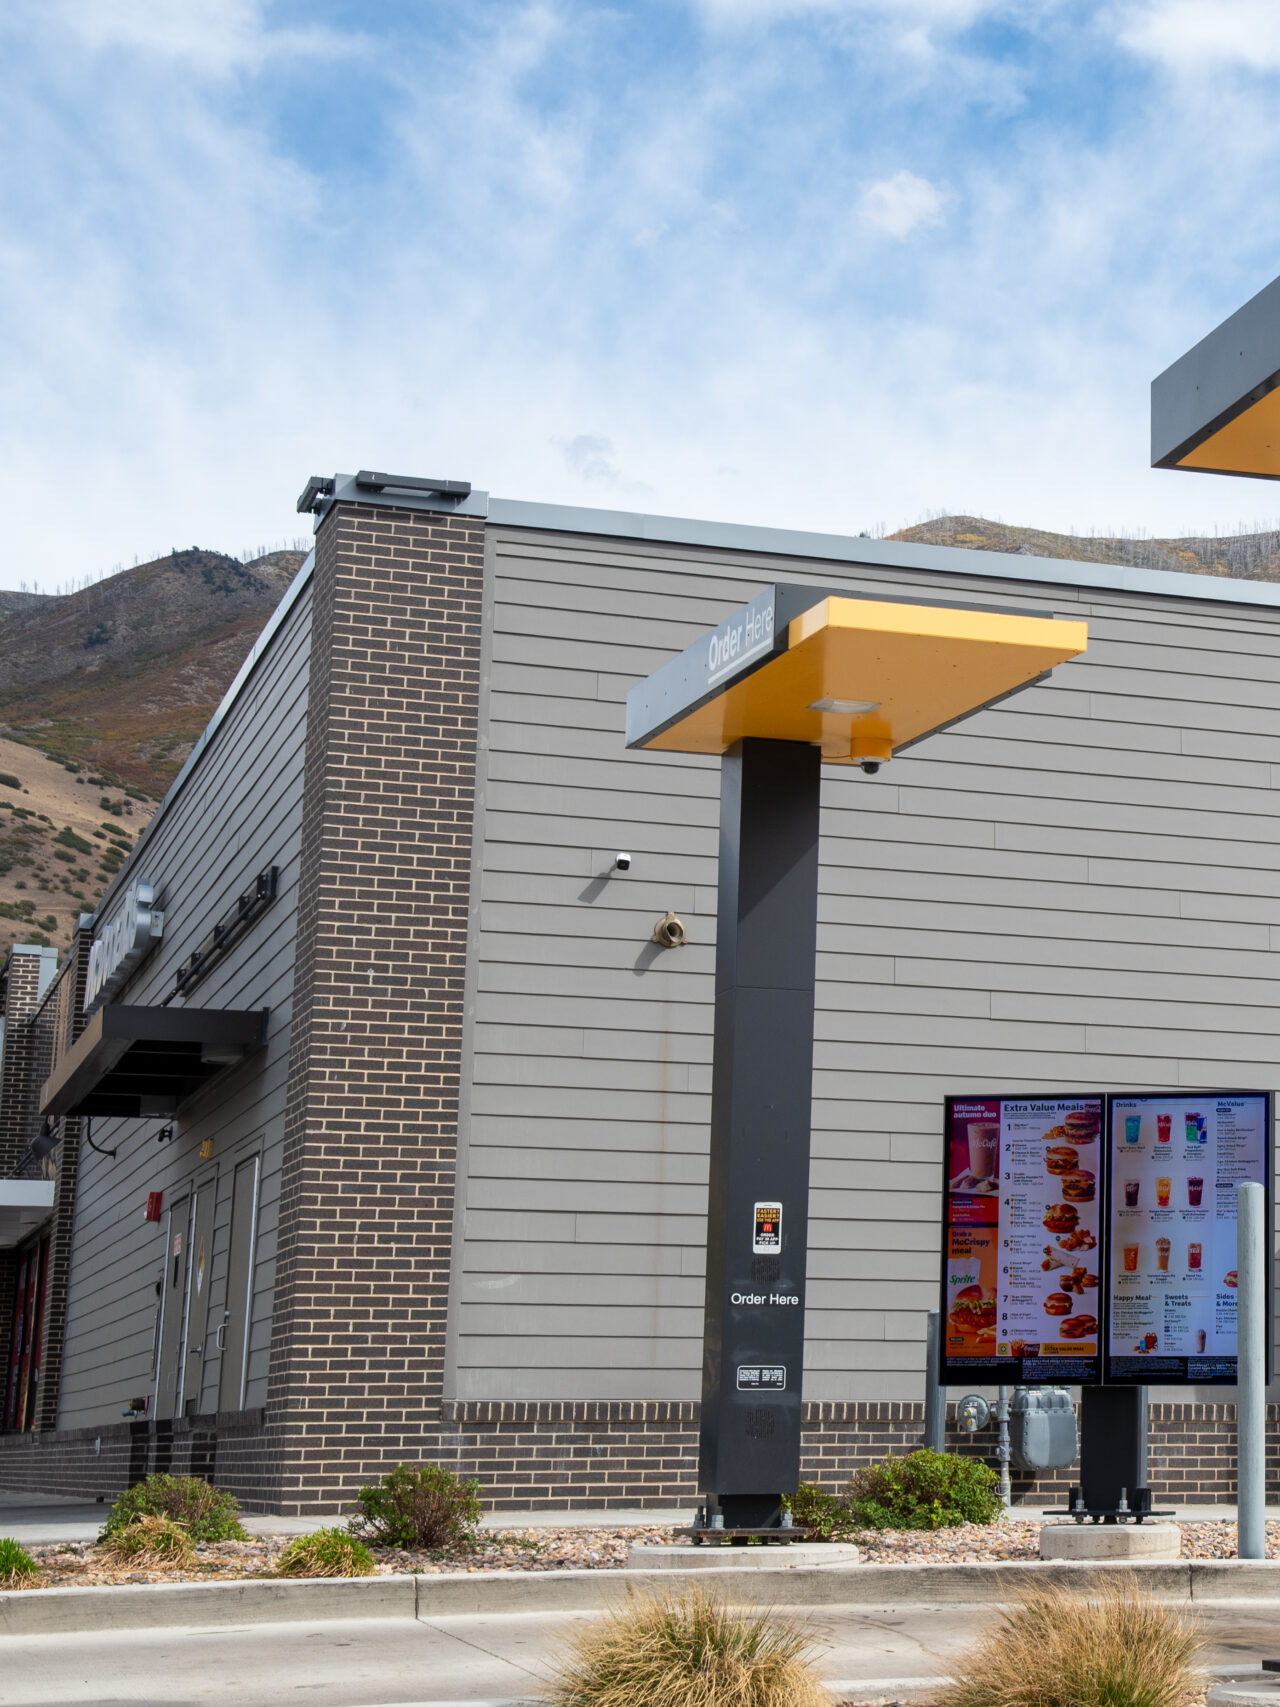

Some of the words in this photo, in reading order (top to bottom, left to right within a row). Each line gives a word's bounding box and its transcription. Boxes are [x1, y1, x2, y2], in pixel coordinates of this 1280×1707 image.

[708, 625, 743, 671] Order
[745, 606, 772, 647] Here
[1004, 1104, 1028, 1112] Extra
[1030, 1104, 1055, 1112] Value
[1057, 1103, 1084, 1111] Meals
[1006, 1123, 1011, 1131] 1
[1005, 1143, 1011, 1151] 2
[1004, 1172, 1010, 1180] 3
[1004, 1198, 1010, 1206] 4
[952, 1238, 990, 1248] McCrispy
[1003, 1239, 1009, 1247] 5
[1003, 1266, 1009, 1274] 6
[950, 1275, 976, 1286] Sprite
[730, 1292, 767, 1305] Order
[769, 1293, 799, 1306] Here
[1002, 1295, 1009, 1303] 7
[1113, 1294, 1134, 1302] Happy
[1002, 1312, 1008, 1321] 8
[1002, 1329, 1008, 1337] 9
